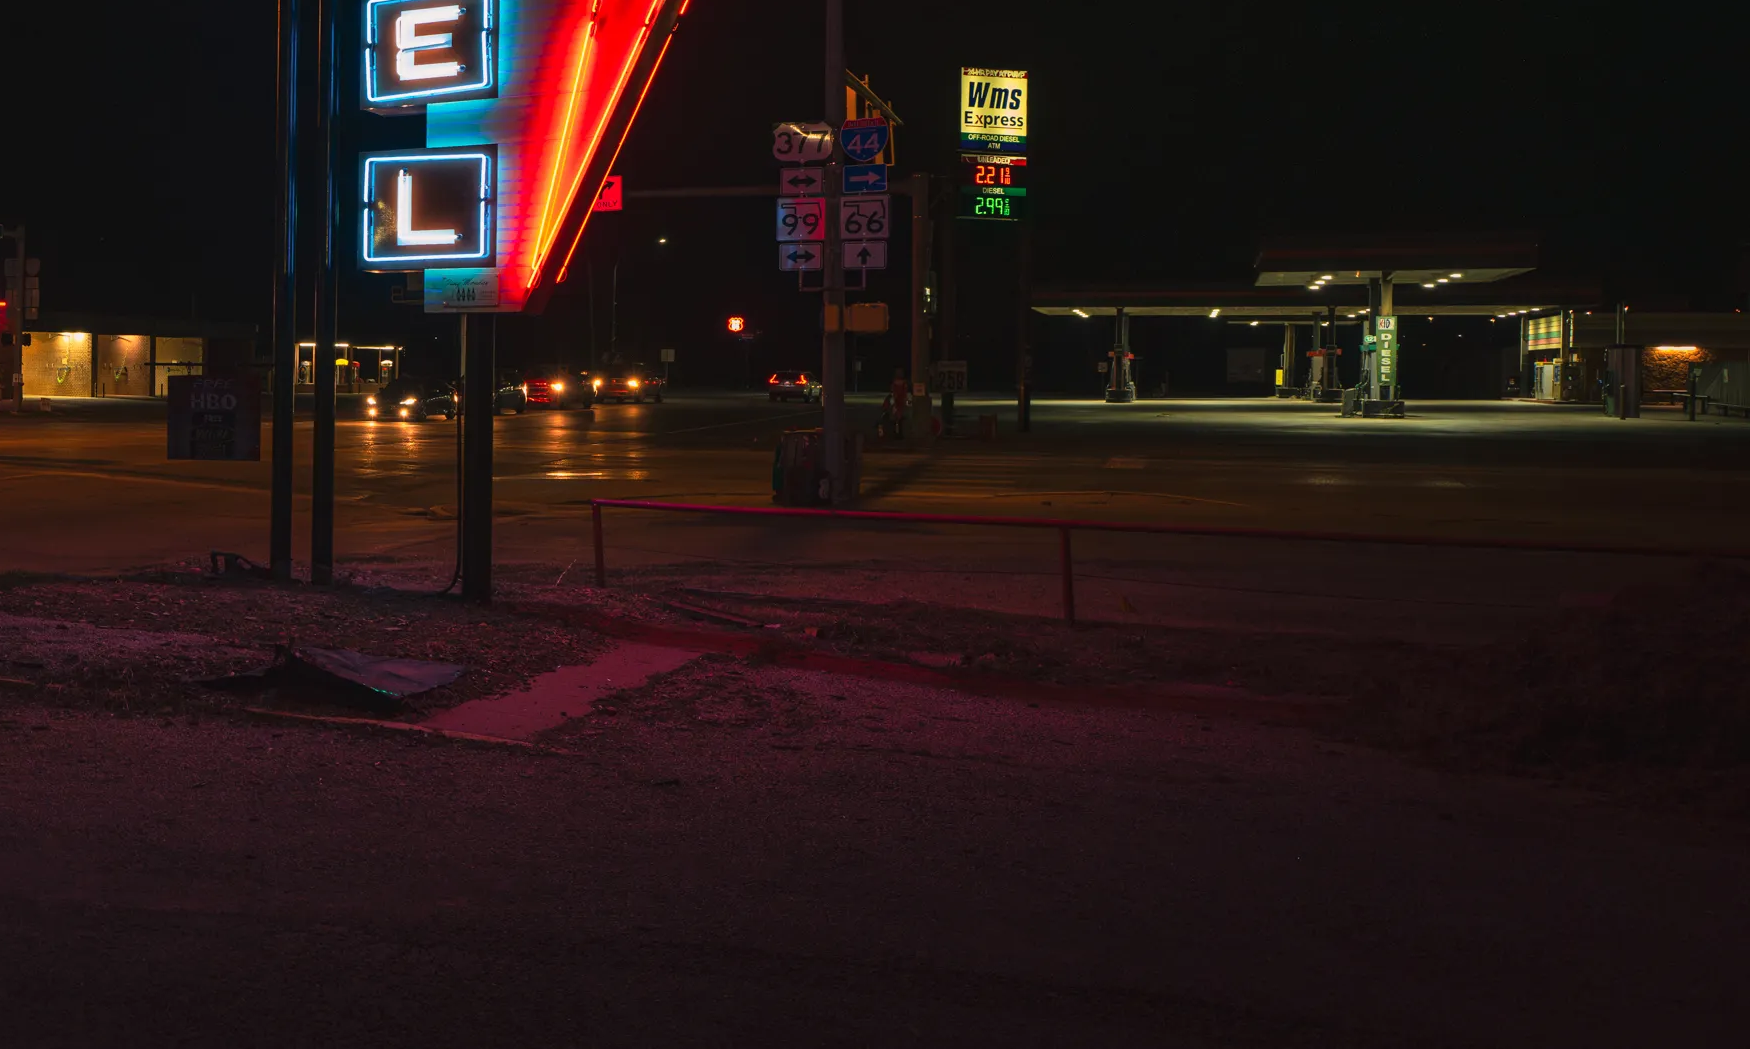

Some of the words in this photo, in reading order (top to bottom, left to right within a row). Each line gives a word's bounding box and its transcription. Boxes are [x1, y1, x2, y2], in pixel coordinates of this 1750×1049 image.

[967, 81, 1023, 110] Wms
[964, 110, 1024, 129] Express
[775, 130, 830, 155] 377
[847, 132, 881, 154] 44
[968, 133, 999, 142] OFF-ROAD
[999, 134, 1020, 143] DIESEL
[977, 155, 1011, 165] UNLEADED
[975, 165, 1004, 184] 2.21
[982, 187, 1005, 195] DIESEL
[596, 200, 618, 209] ONLY
[975, 197, 1004, 215] 2.99
[782, 213, 819, 236] 99
[844, 211, 885, 234] 66
[1380, 333, 1393, 382] DIESEL
[190, 392, 237, 410] HBO
